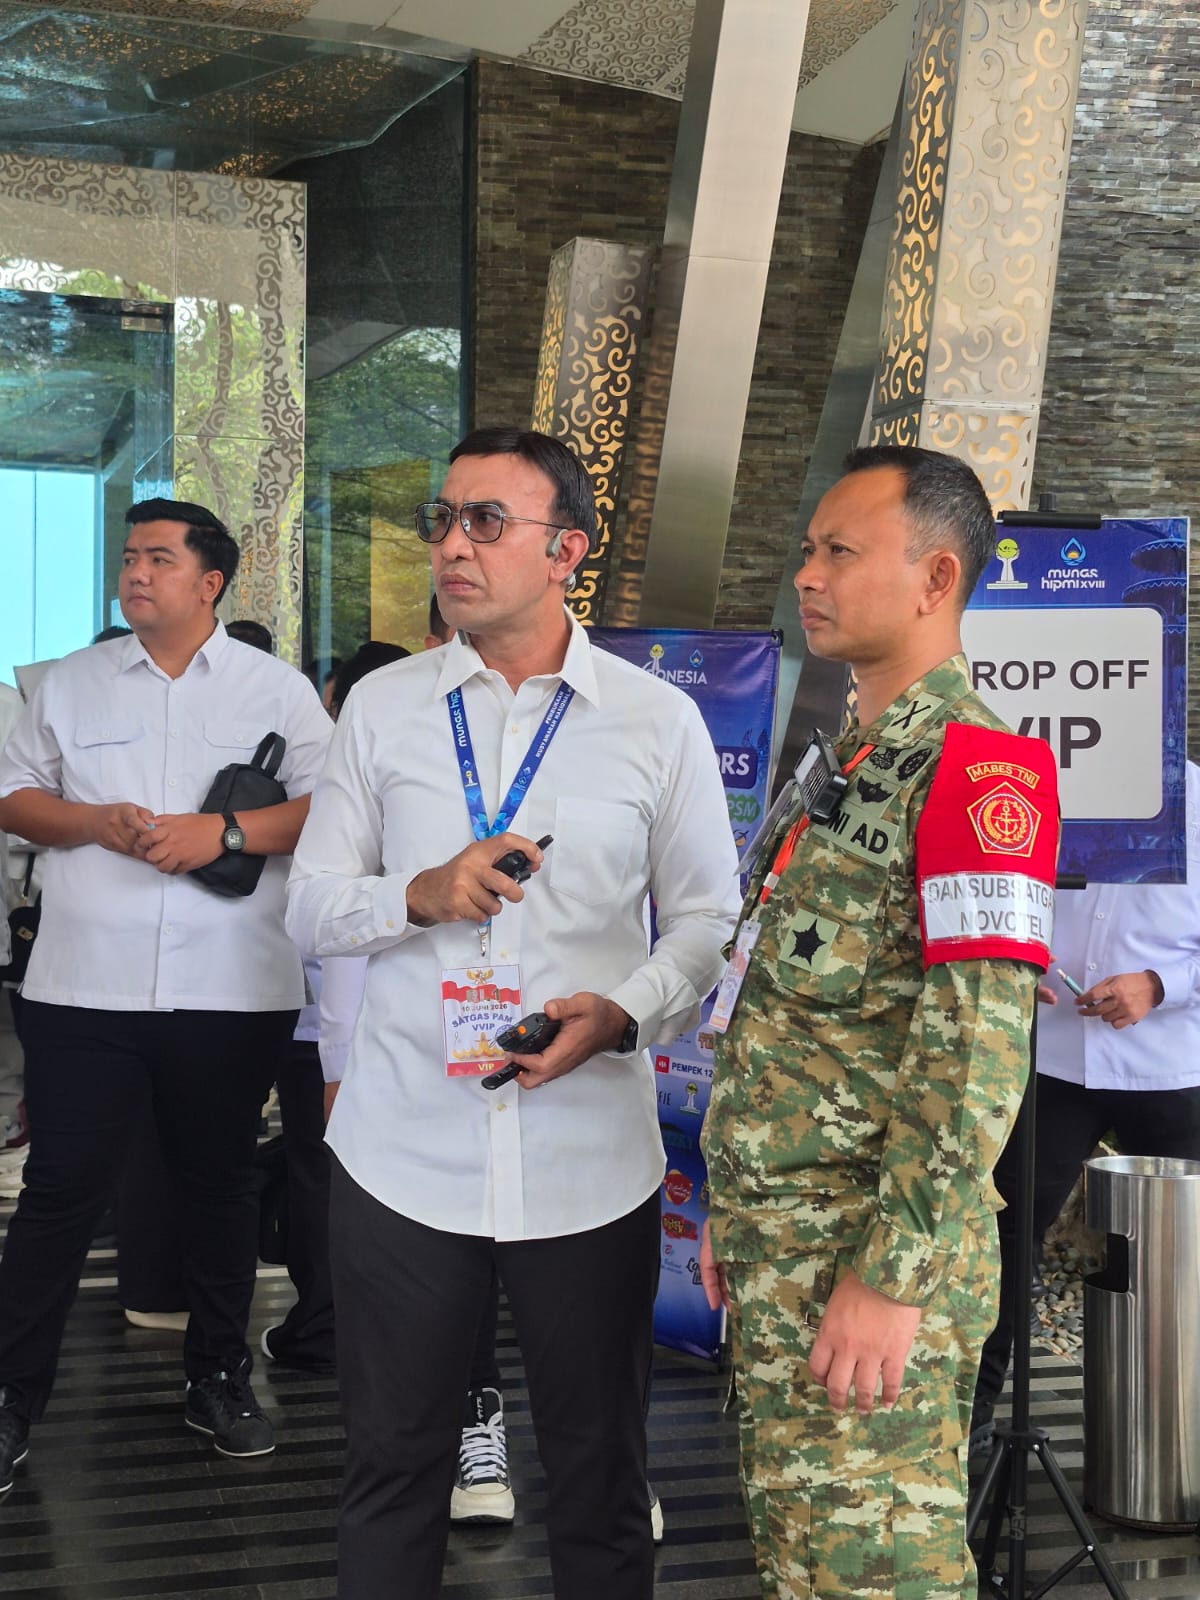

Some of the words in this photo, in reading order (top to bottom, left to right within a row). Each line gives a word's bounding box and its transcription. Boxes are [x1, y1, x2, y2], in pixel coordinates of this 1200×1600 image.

[1048, 568, 1099, 579] munas
[971, 660, 1057, 691] ROP
[1069, 659, 1150, 690] OFF
[453, 709, 468, 748] munas
[716, 752, 751, 776] RS
[971, 764, 1013, 778] MABES
[1017, 768, 1036, 785] TNI
[827, 808, 851, 836] NI
[849, 822, 889, 855] AD
[452, 1012, 490, 1028] SATGAS
[492, 1013, 513, 1024] PAM
[472, 1023, 495, 1032] VVIP
[478, 1062, 495, 1072] VIP
[671, 1062, 702, 1076] PEMPEK
